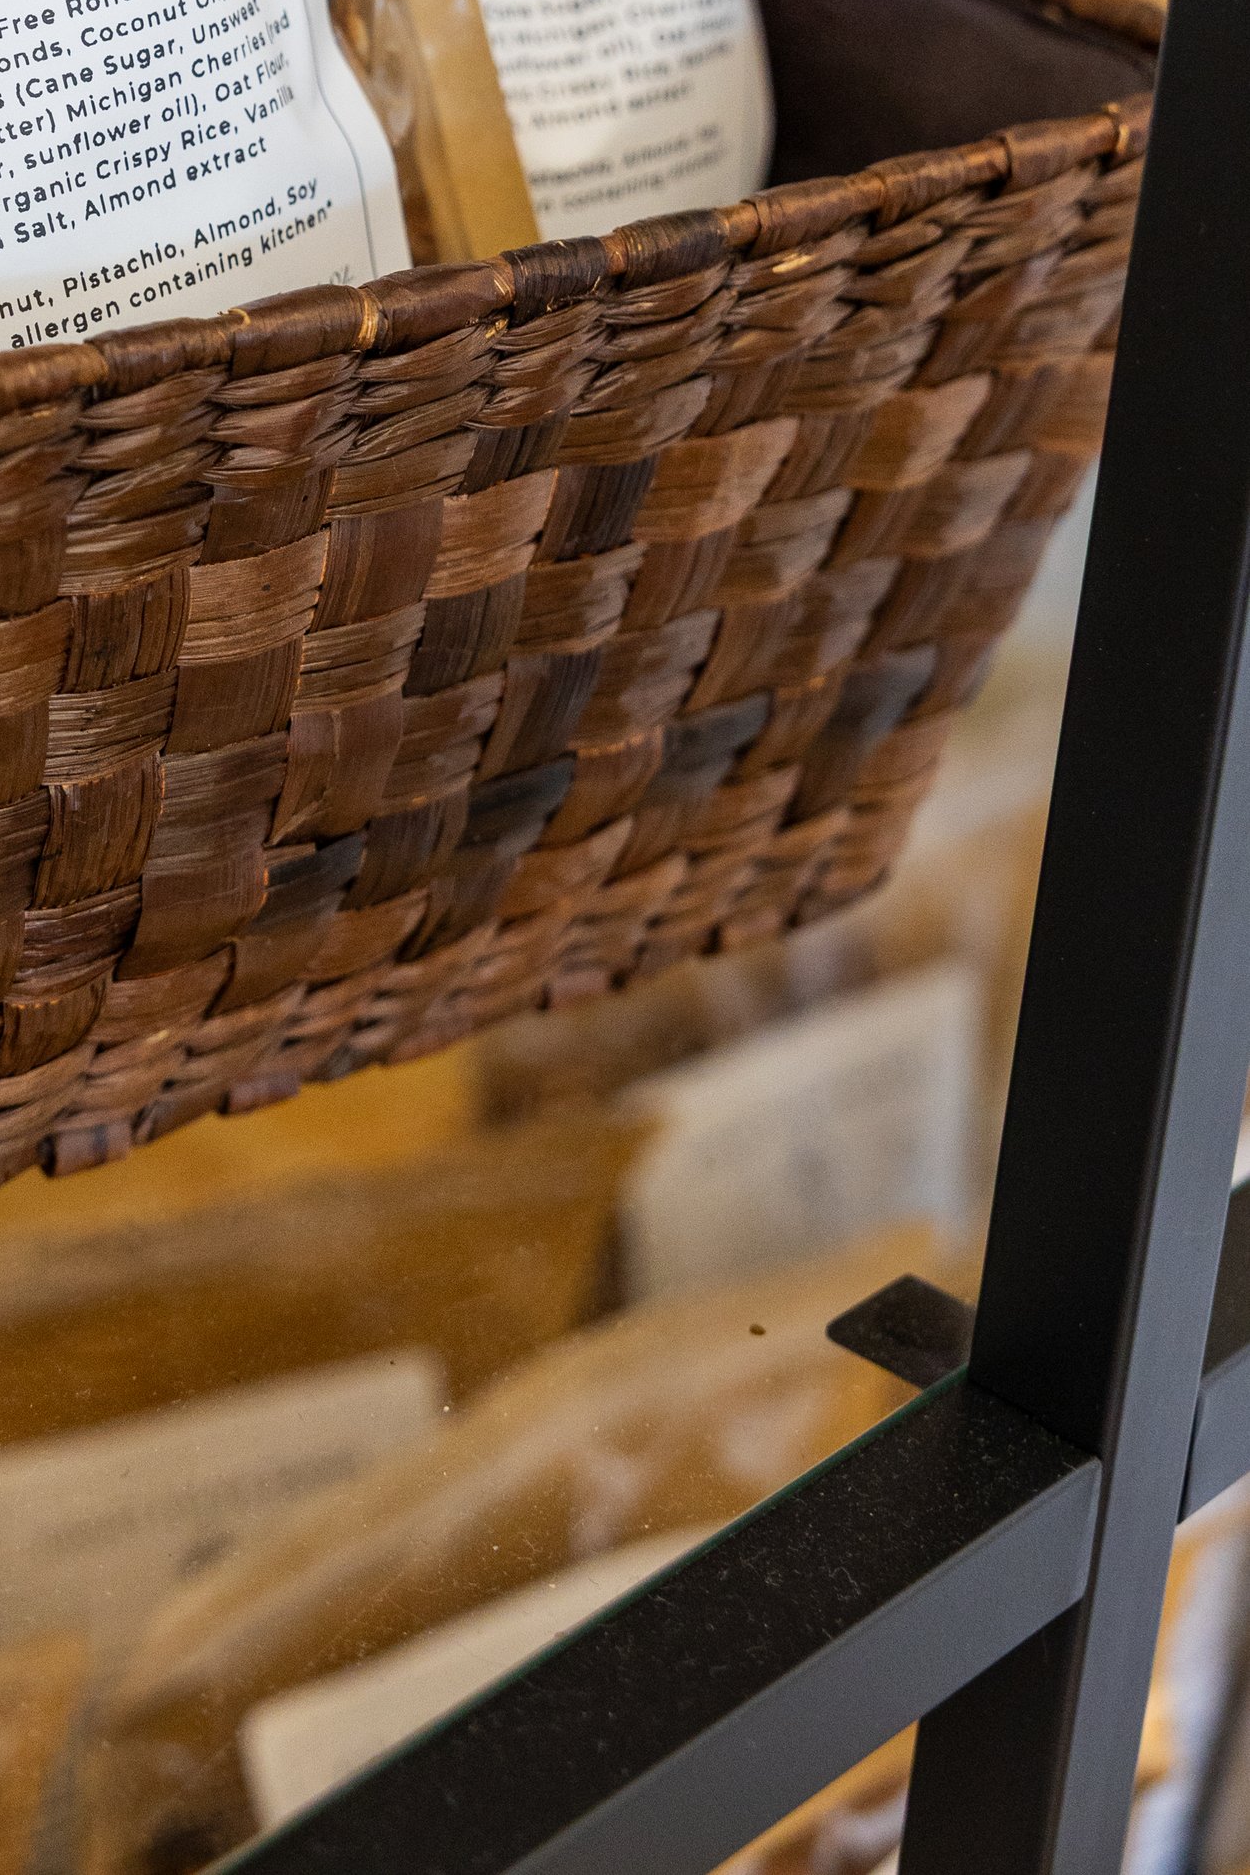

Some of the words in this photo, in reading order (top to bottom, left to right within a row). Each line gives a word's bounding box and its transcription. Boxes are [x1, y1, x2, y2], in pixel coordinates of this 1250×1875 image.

[15, 66, 94, 108] (Cane
[102, 38, 184, 76] Sugar,
[65, 70, 183, 123] Michigan
[190, 31, 267, 79] Cherries
[23, 113, 152, 171] sunflower
[160, 92, 207, 123] oil),
[214, 74, 253, 103] Oat
[95, 140, 172, 180] Crispy
[180, 119, 239, 151] Rice,
[243, 85, 295, 124] Vanilla
[13, 211, 76, 244] Salt,
[84, 167, 177, 222] Almond
[185, 135, 268, 182] extract
[62, 241, 186, 299] Pistachio,
[193, 196, 282, 250] Almond,
[286, 177, 318, 206] Soy
[10, 300, 121, 350] allergen
[128, 246, 254, 309] containing
